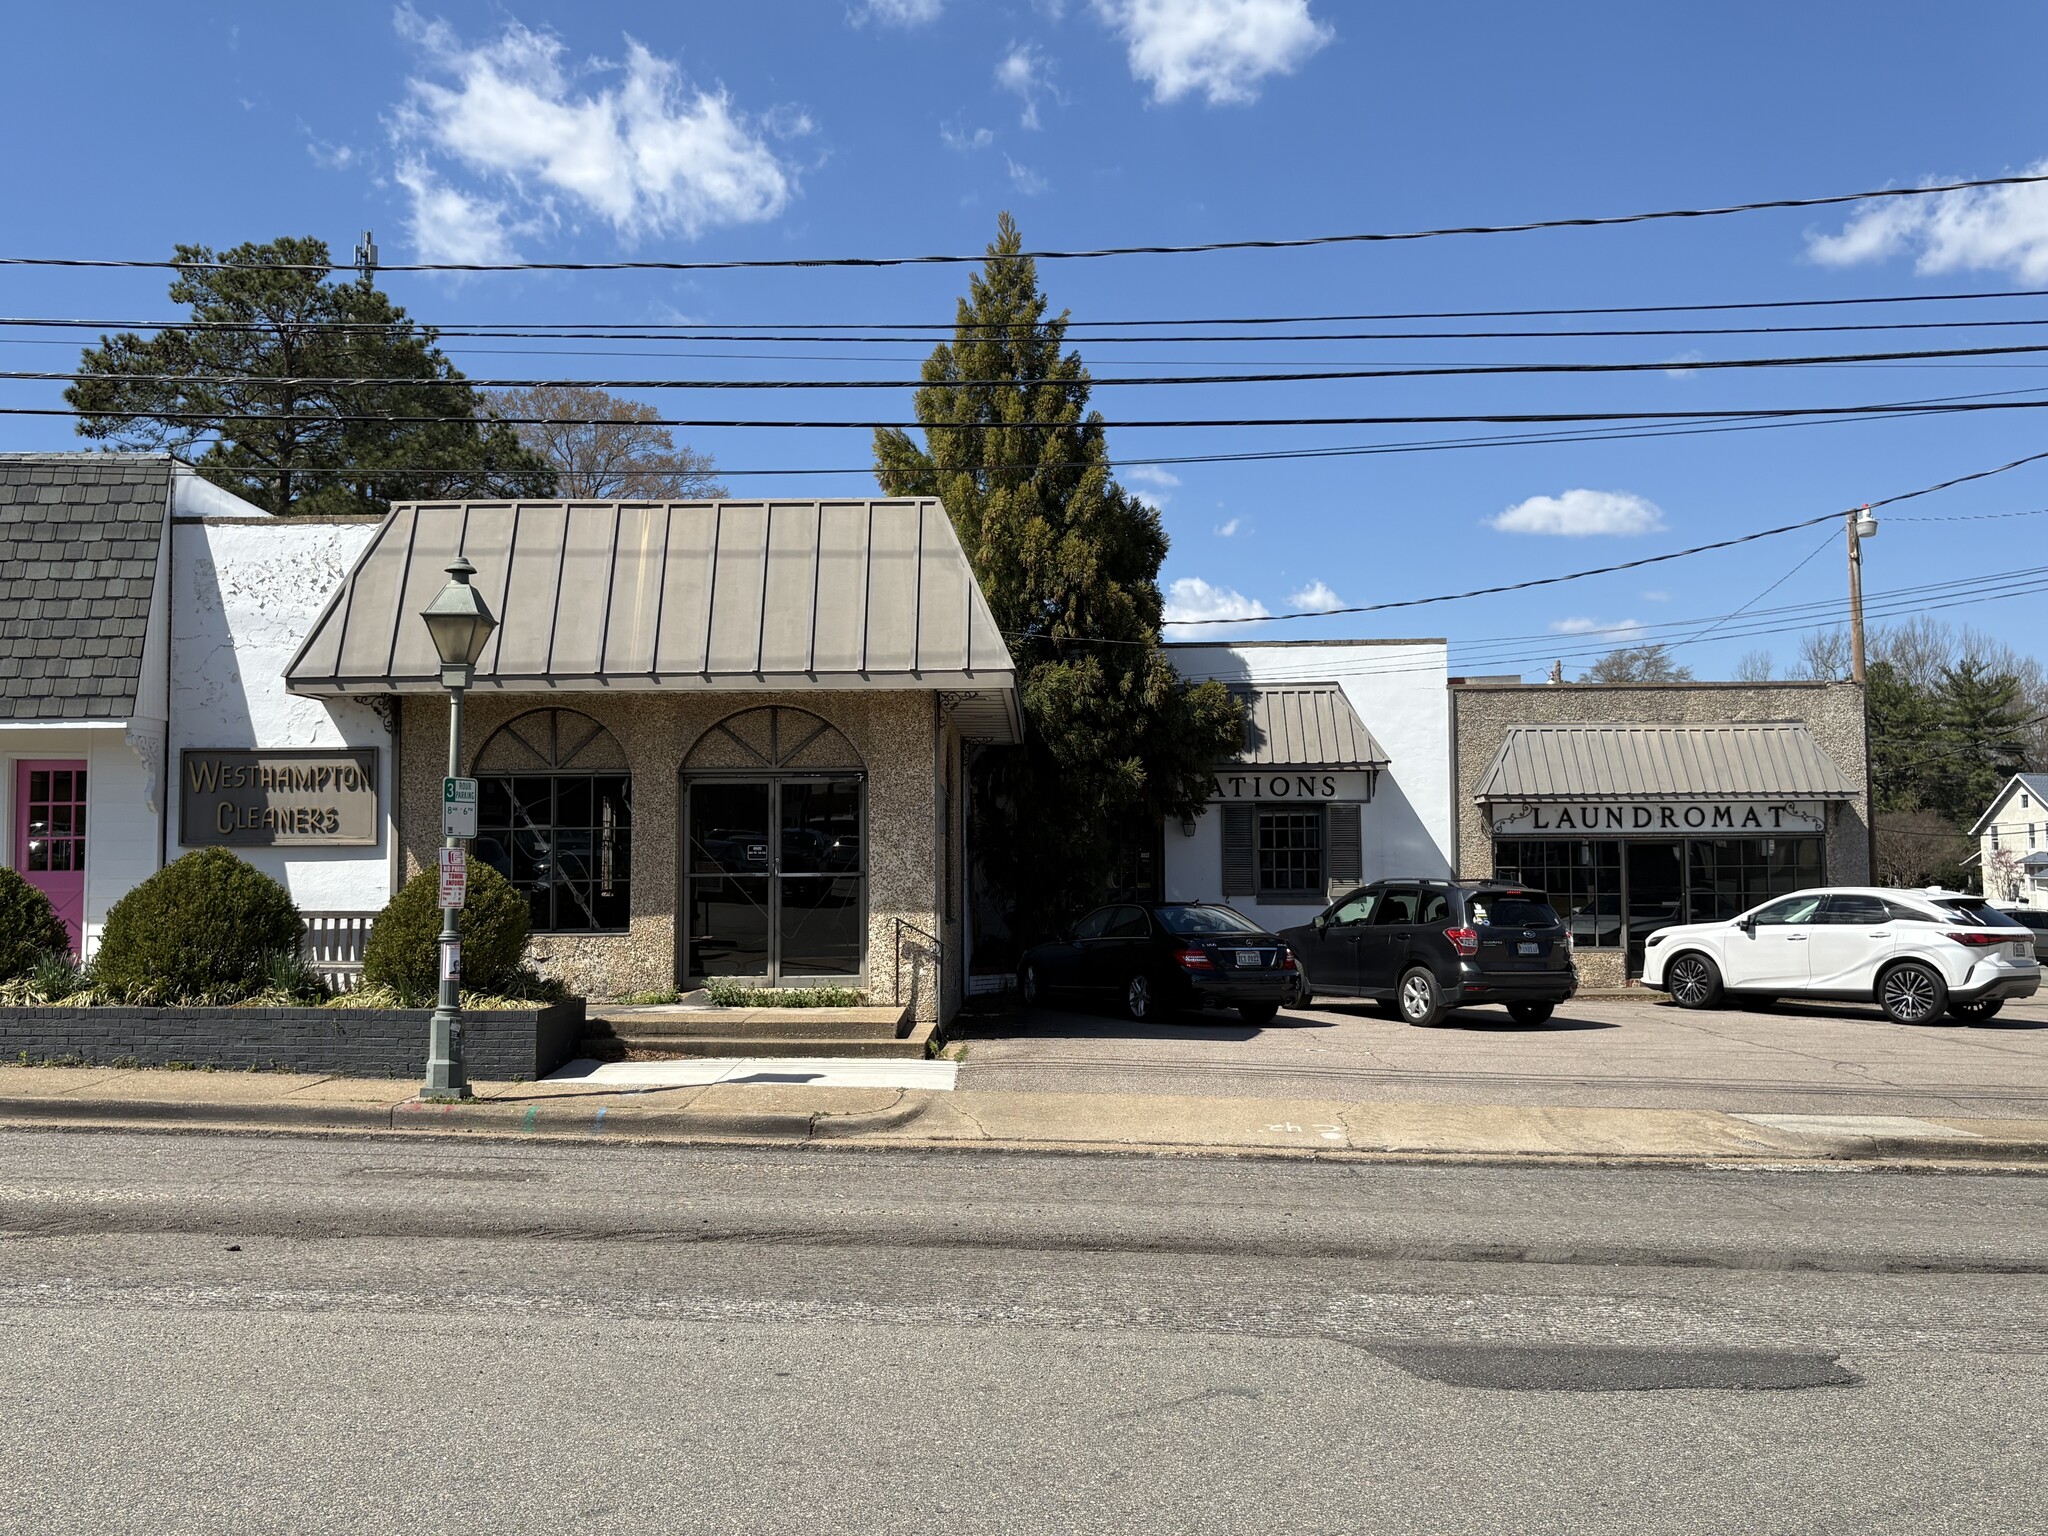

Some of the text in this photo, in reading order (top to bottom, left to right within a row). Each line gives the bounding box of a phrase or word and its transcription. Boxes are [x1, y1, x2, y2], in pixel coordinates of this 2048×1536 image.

[188, 760, 369, 793] WESTHAMPTON
[458, 781, 472, 790] HOUR
[1205, 776, 1336, 798] ATIONS
[446, 782, 454, 798] 3
[455, 790, 475, 800] PARKING
[216, 801, 337, 834] CLEANERS
[1532, 805, 1787, 829] LAUNDROMAT
